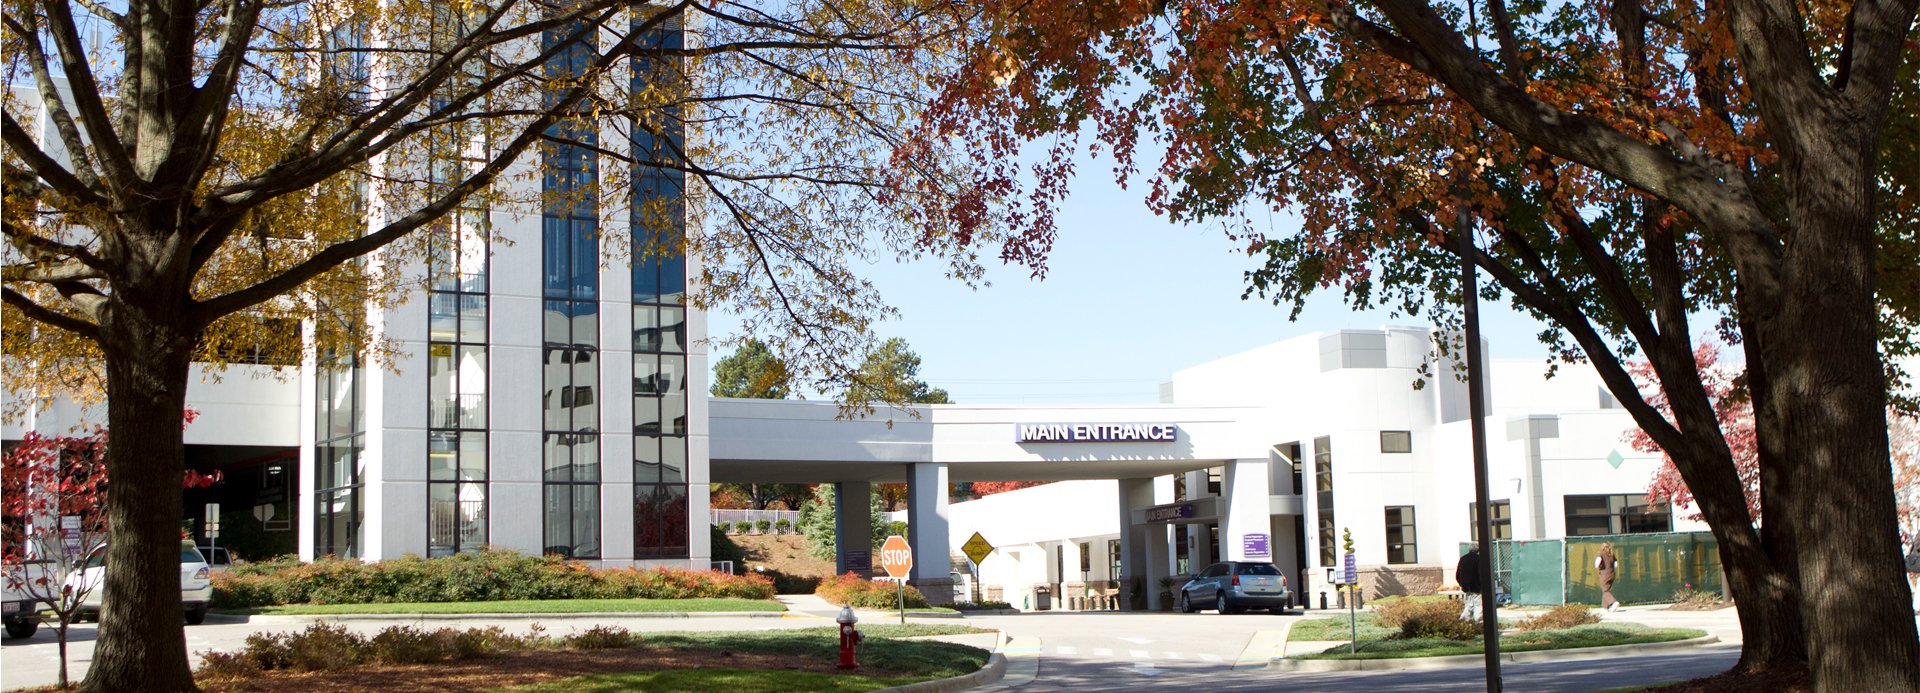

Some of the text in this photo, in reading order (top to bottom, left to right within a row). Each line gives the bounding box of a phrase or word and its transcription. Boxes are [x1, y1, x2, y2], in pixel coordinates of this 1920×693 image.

[1020, 423, 1175, 441] MAIN ENTRANCE
[1156, 506, 1182, 519] ENTRANCE
[884, 549, 910, 567] STOP
